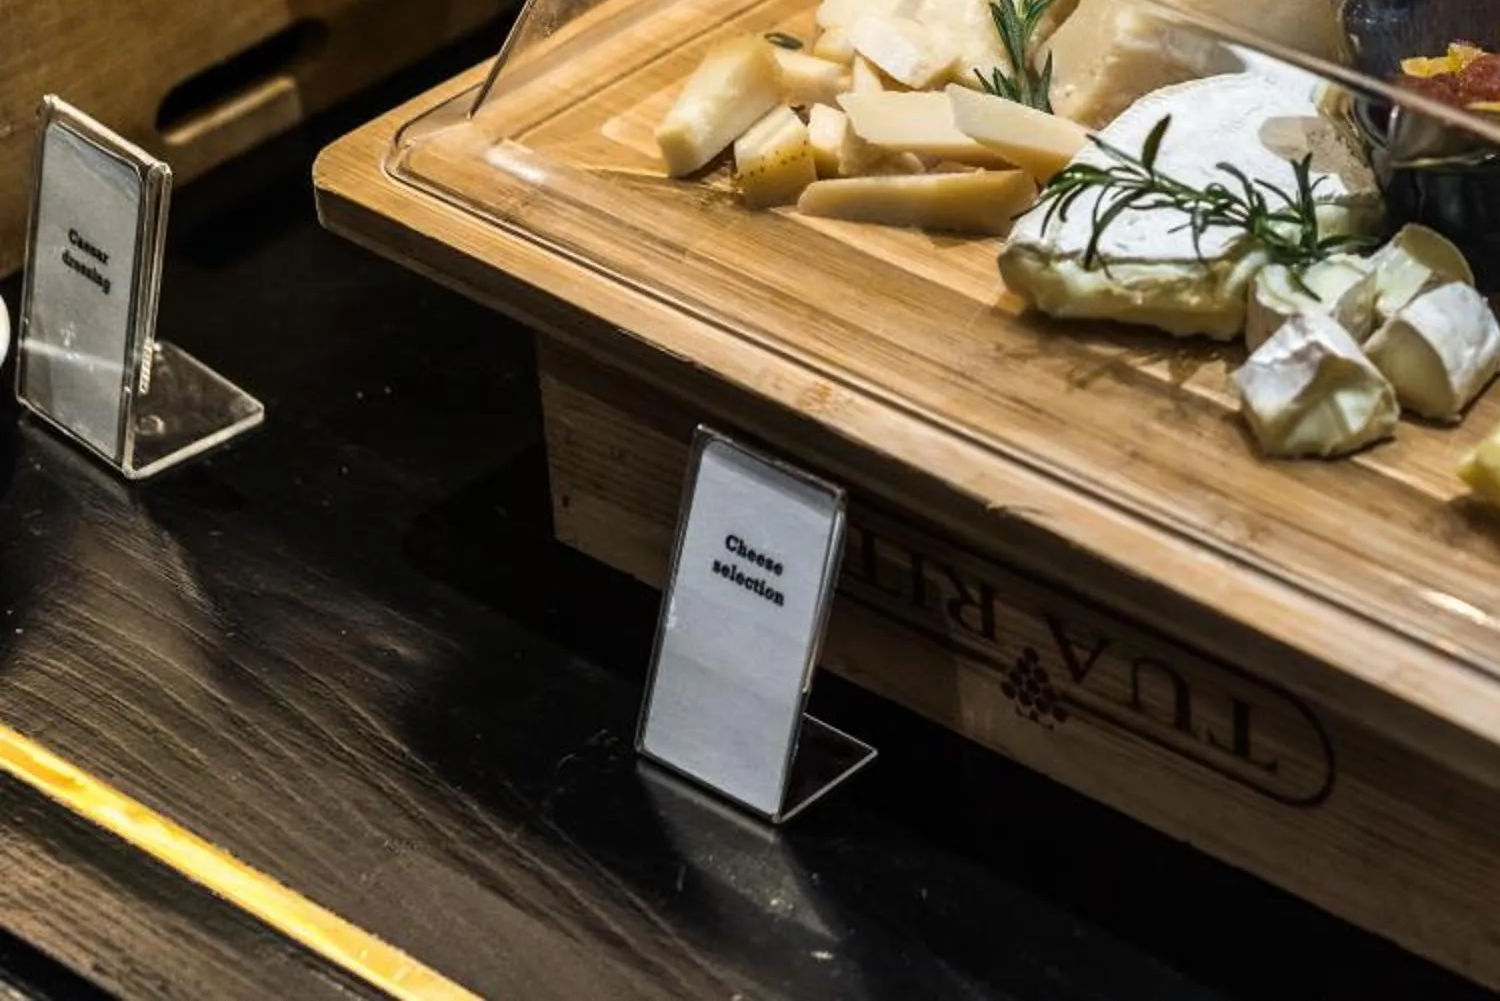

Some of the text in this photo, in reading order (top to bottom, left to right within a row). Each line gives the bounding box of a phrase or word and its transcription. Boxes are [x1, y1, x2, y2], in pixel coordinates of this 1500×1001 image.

[725, 534, 783, 576] Cheese
[712, 559, 784, 607] selection
[842, 523, 1279, 770] TUA RIT
